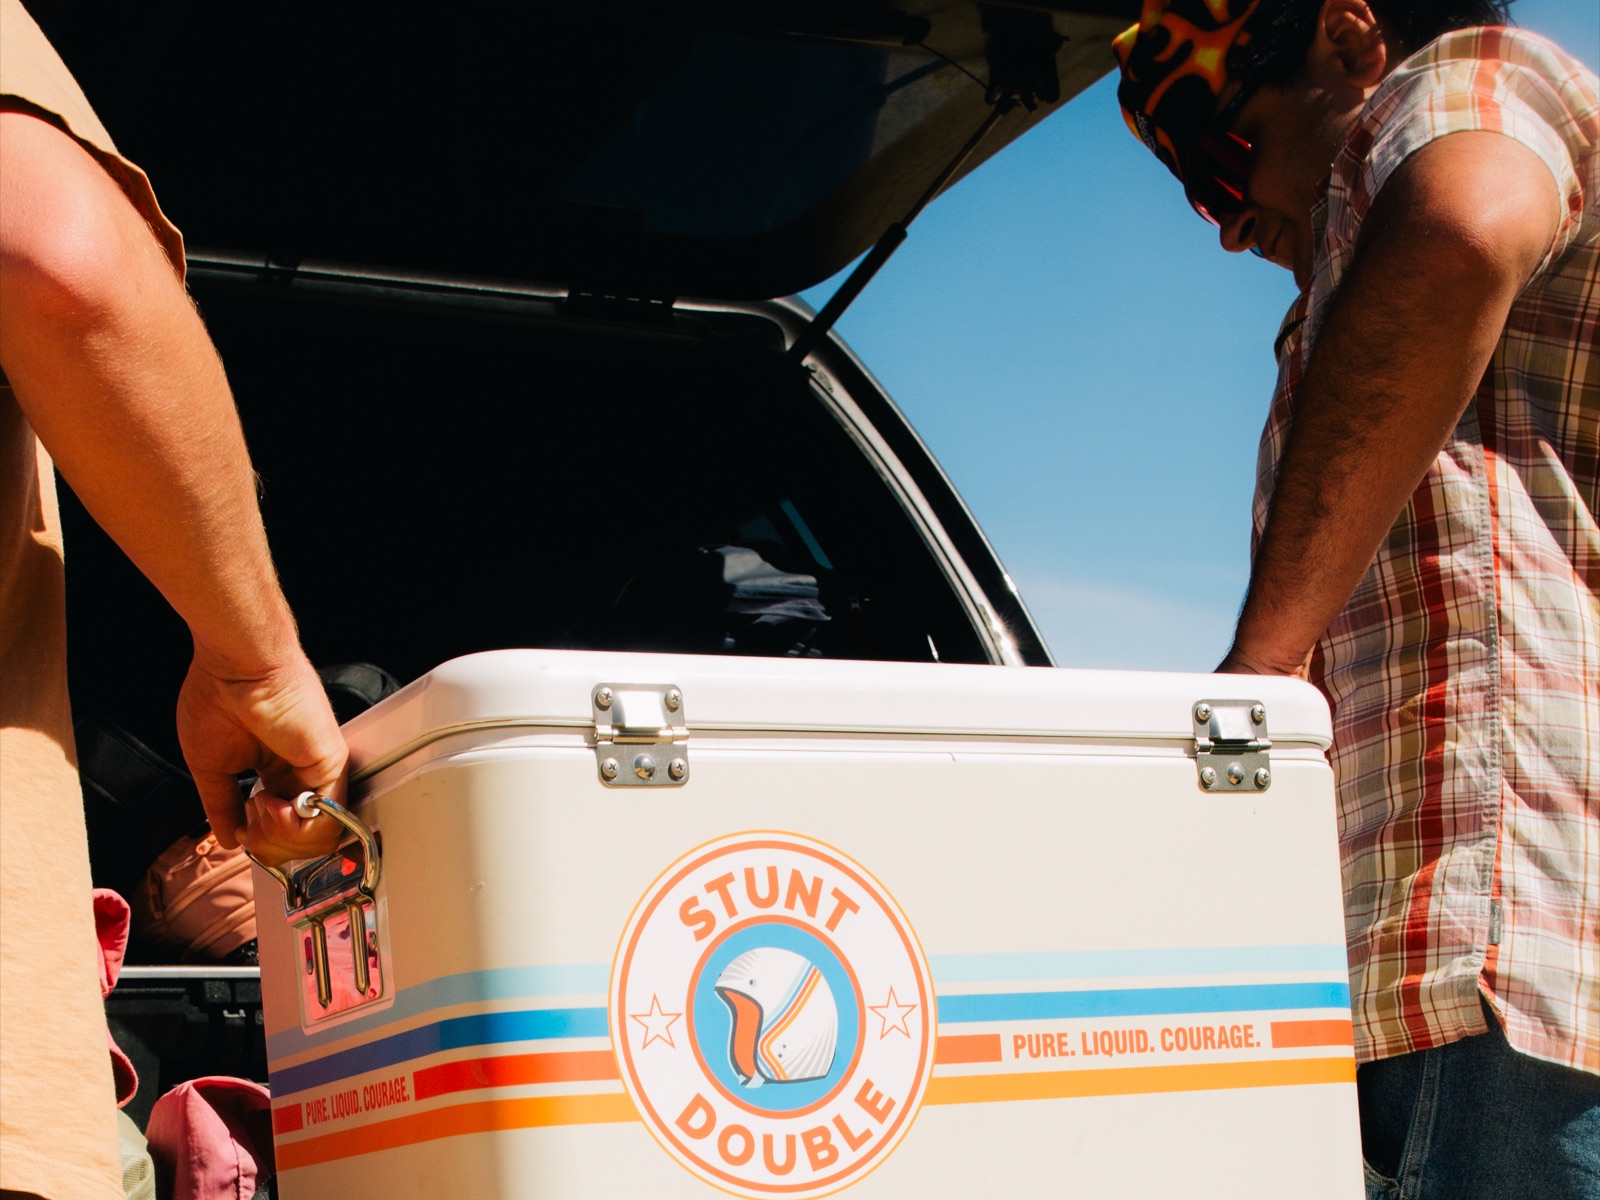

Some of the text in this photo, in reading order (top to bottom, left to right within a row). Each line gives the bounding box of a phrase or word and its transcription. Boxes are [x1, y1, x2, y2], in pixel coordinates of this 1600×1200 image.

[678, 865, 861, 942] STUNT
[1012, 1024, 1261, 1059] PURE. LIQUID. COURAGE.
[305, 1076, 410, 1126] PURE. LIQUID. COURAGE.
[674, 1078, 896, 1176] DOUBLE
